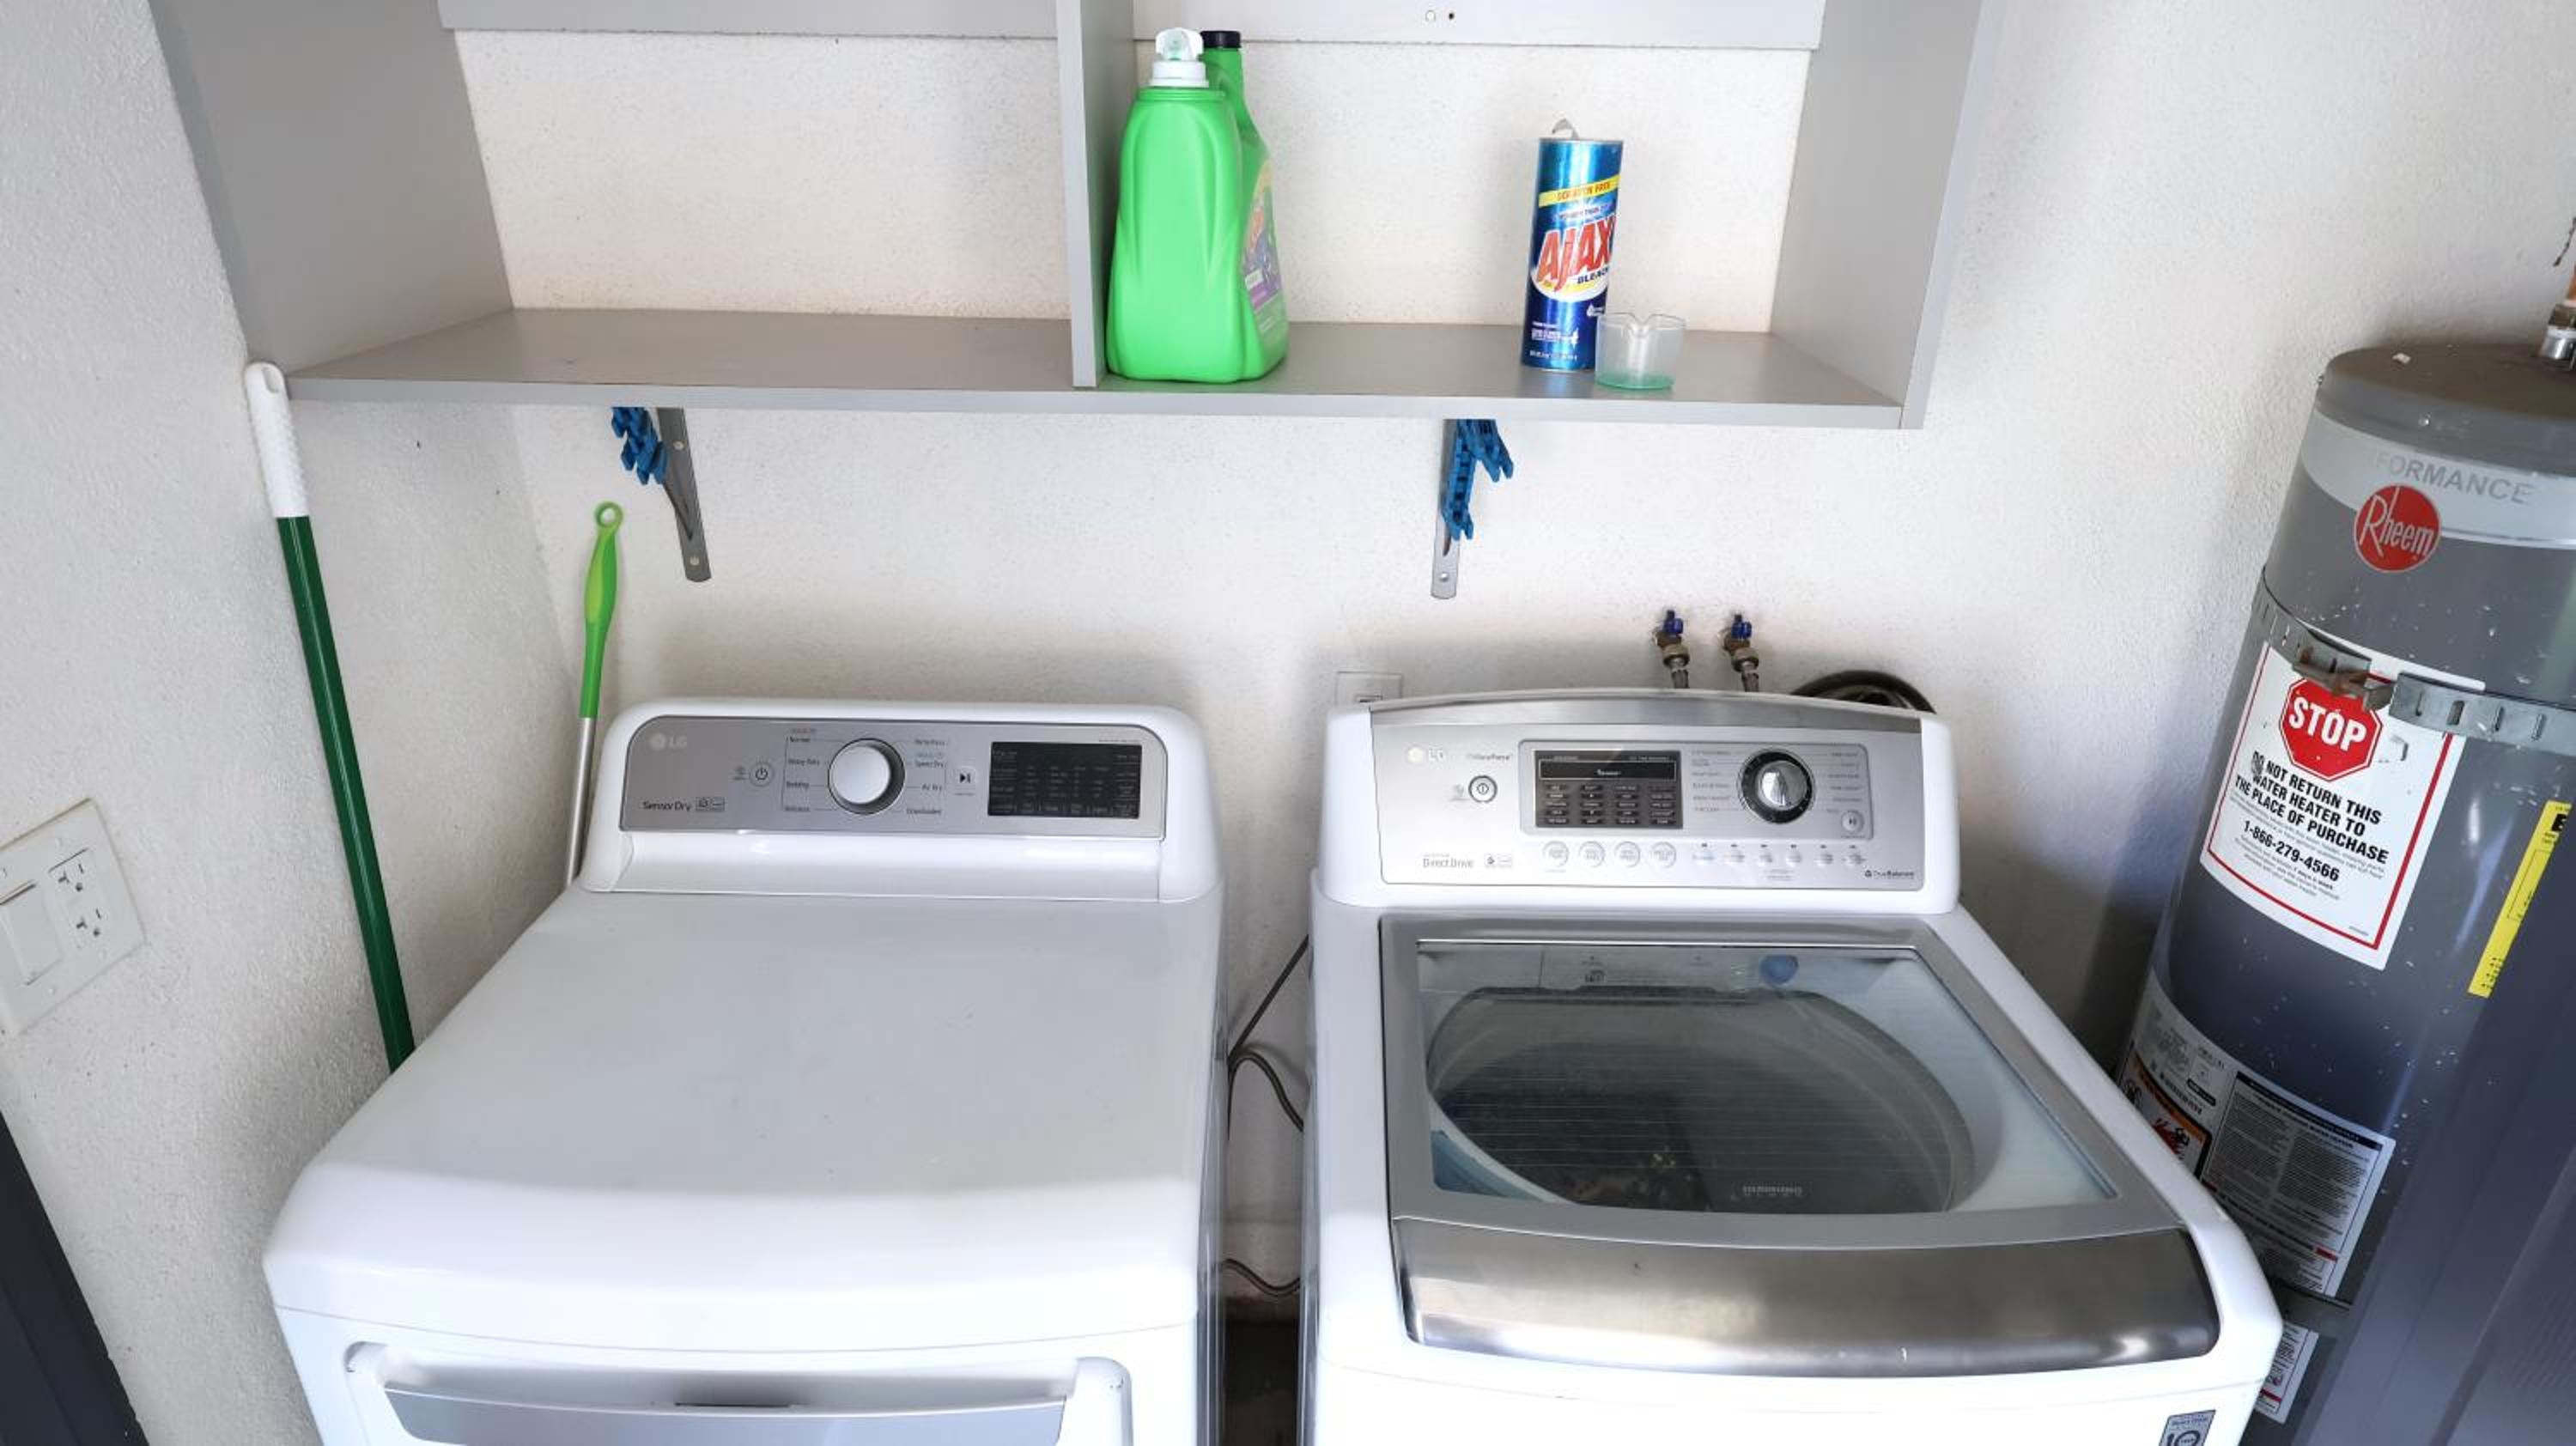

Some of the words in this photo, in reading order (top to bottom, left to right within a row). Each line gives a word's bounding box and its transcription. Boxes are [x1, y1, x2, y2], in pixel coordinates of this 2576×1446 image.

[1595, 181, 1611, 195] FREE
[1537, 216, 1617, 291] AJAX
[2359, 486, 2435, 559] Rheem
[2289, 696, 2367, 752] STOP
[2235, 774, 2251, 796] THE
[2251, 787, 2286, 818] PLACE
[2287, 810, 2306, 826] OF
[2306, 819, 2390, 865] PURCHASE
[2252, 775, 2287, 800] WATER
[2288, 792, 2341, 827] HEATER
[2345, 817, 2366, 837] TO
[2266, 760, 2288, 782] NOT
[2288, 774, 2342, 809] RETURN
[2346, 799, 2382, 825] THIS
[2243, 820, 2341, 882] 1-866-279-4566
